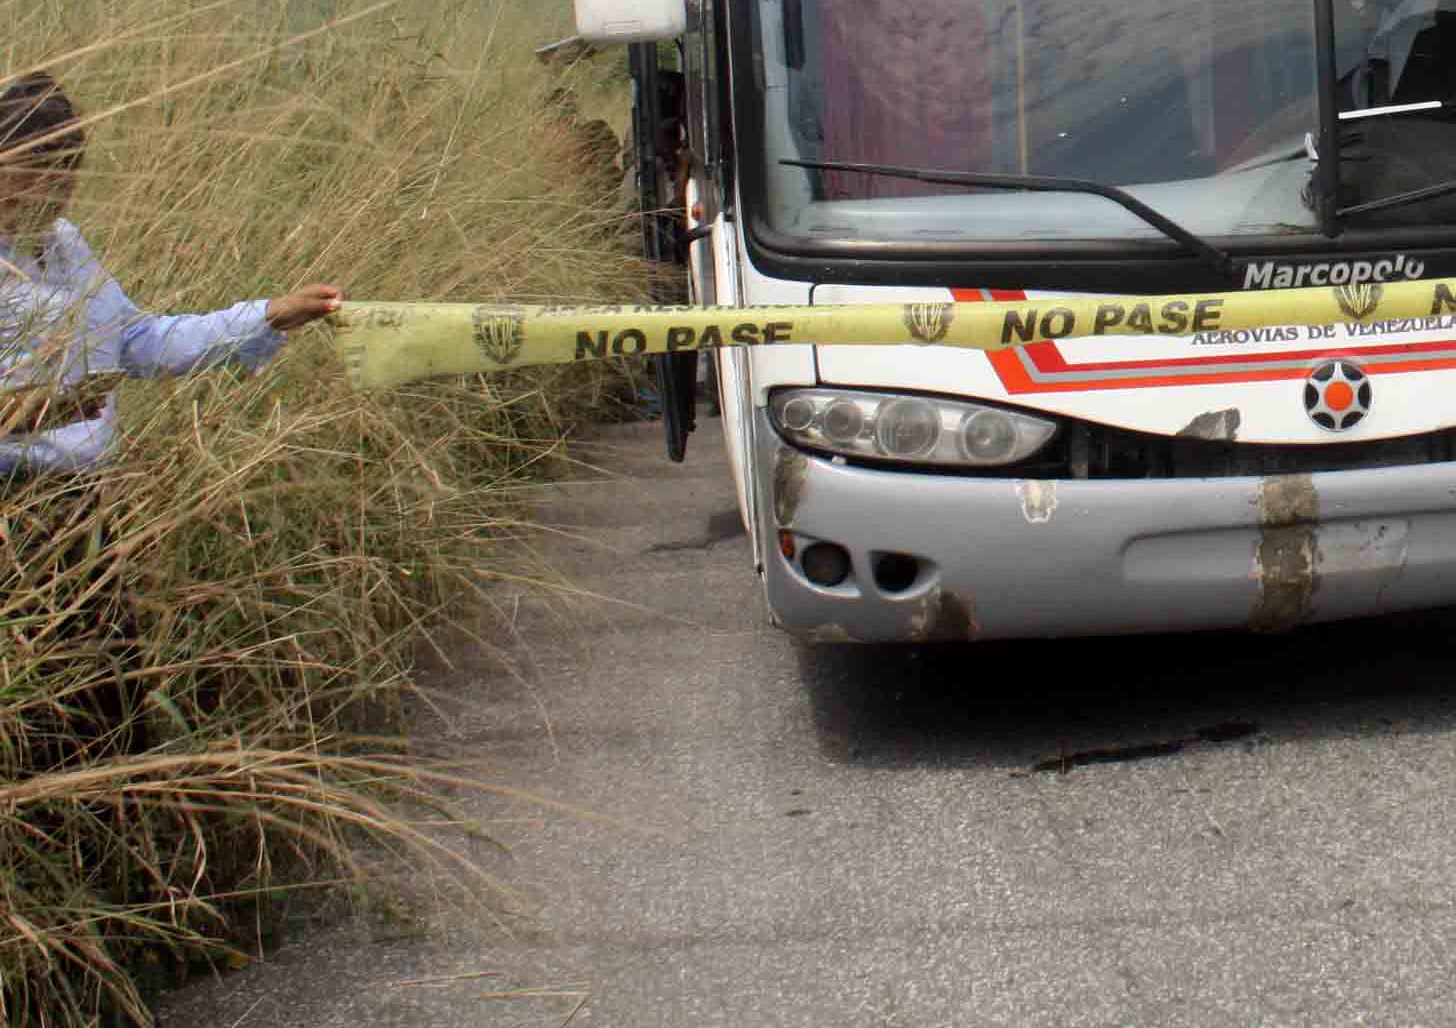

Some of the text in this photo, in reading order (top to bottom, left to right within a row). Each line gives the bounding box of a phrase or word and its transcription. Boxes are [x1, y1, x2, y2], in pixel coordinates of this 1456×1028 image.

[1242, 255, 1425, 290] Marcopolo
[1001, 299, 1224, 344] NO PASE
[1192, 325, 1299, 345] AEROVIAS
[1307, 323, 1337, 340] DE
[575, 322, 793, 361] NO PASE
